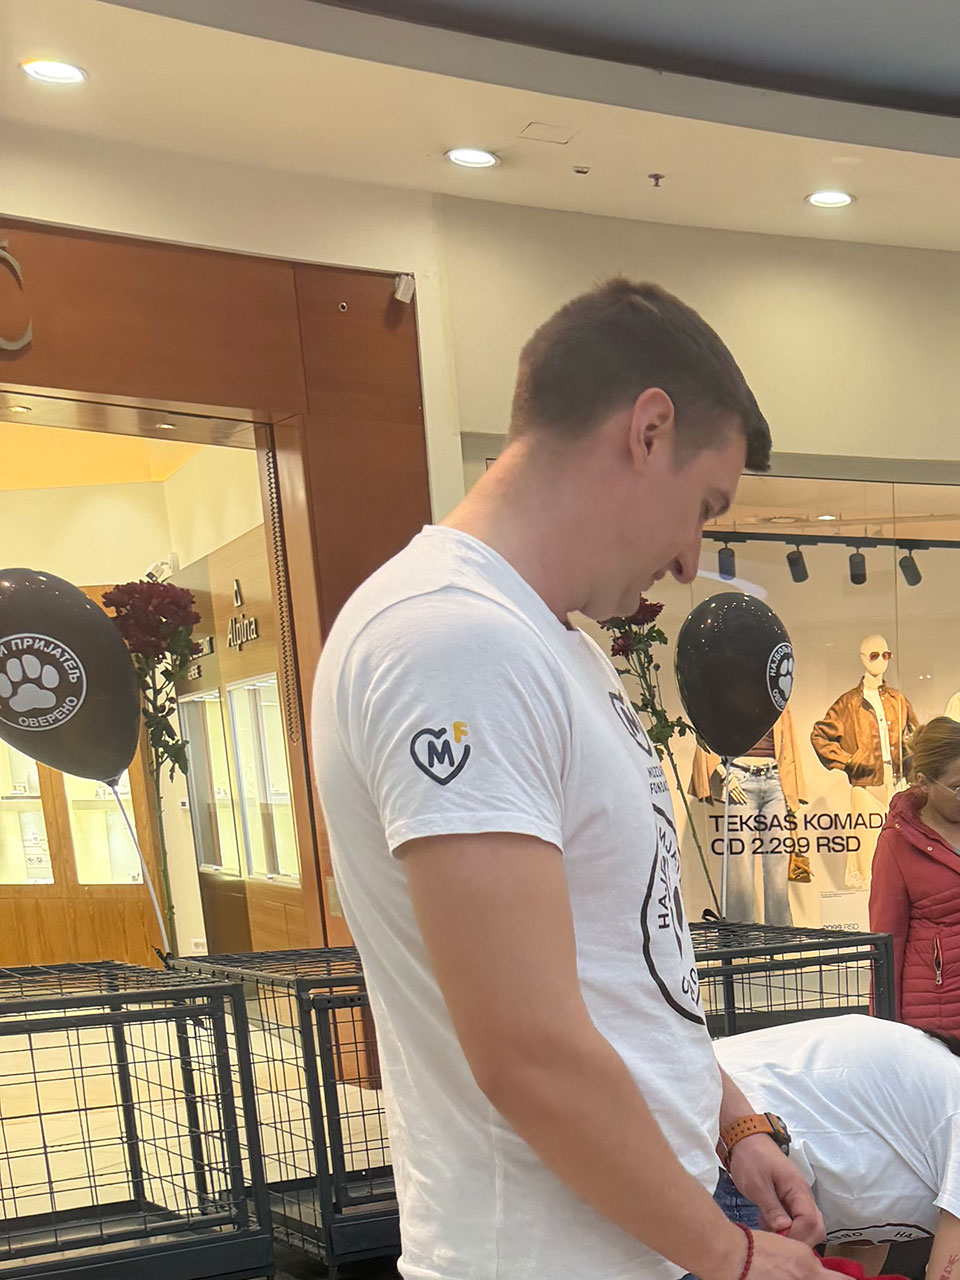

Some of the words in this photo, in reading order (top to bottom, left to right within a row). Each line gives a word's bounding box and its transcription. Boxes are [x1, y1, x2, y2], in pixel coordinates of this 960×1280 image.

[227, 613, 258, 651] Alpina
[11, 638, 80, 683] ПРИЈАТЕЉ
[18, 696, 78, 727] ОВЕРЕНО
[709, 814, 798, 832] TEKSAS
[711, 837, 745, 856] OD
[751, 837, 810, 855] 2.299
[816, 836, 861, 854] RSD
